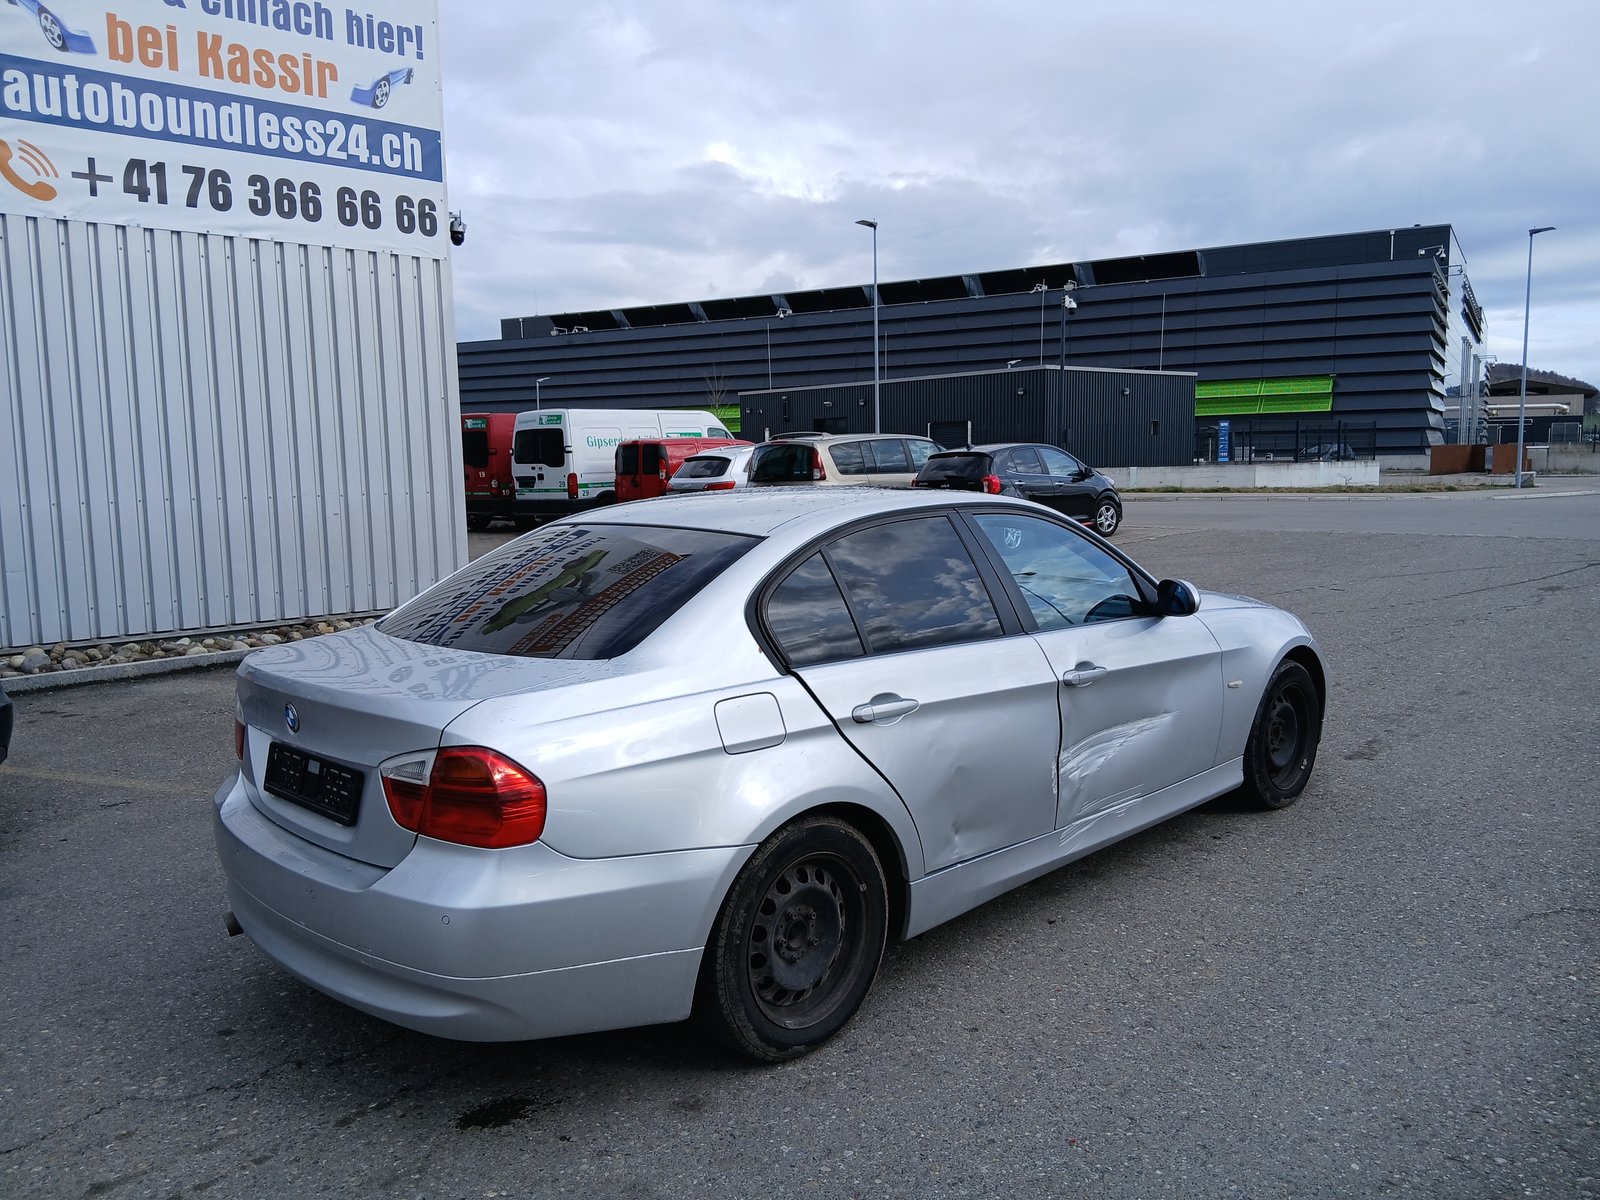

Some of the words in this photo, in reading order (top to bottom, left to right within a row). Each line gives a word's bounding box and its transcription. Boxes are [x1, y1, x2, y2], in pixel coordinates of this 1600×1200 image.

[106, 12, 179, 72] bei
[197, 30, 338, 98] Kassir
[345, 9, 424, 60] hier!
[3, 69, 423, 172] autoboundless24.ch
[182, 165, 232, 211] 76
[248, 174, 322, 222] 366
[337, 187, 382, 229] 66
[396, 195, 438, 237] 66
[559, 480, 566, 488] 29
[582, 489, 590, 497] 29
